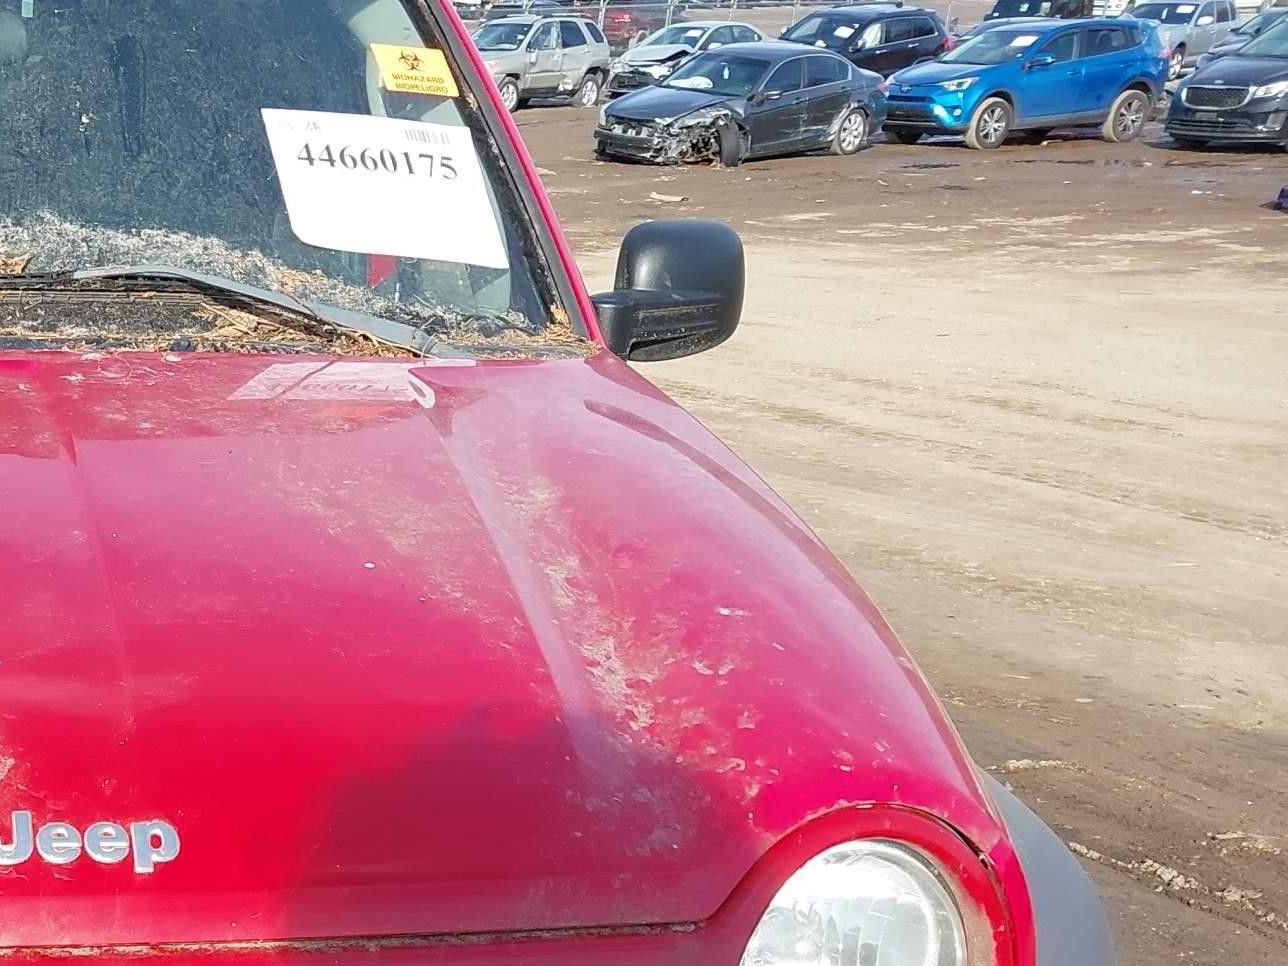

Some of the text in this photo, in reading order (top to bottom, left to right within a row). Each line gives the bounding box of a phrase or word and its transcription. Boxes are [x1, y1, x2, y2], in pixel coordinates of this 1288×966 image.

[392, 73, 444, 84] BIOHAZARD
[395, 82, 448, 94] BIOPELIGRO
[297, 143, 458, 180] 44660175
